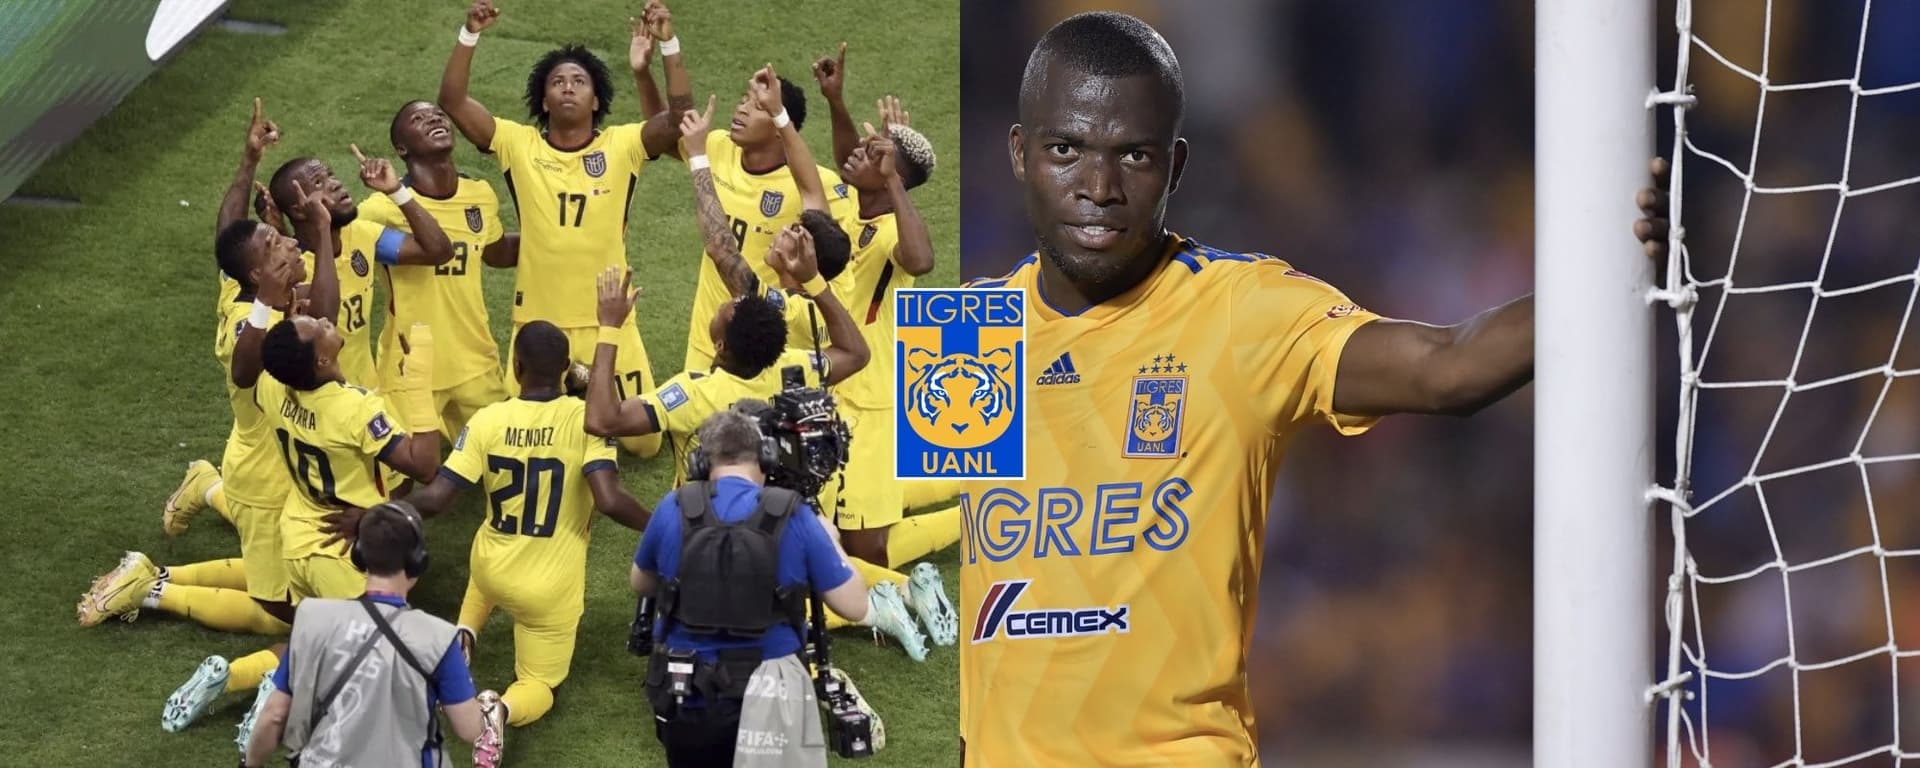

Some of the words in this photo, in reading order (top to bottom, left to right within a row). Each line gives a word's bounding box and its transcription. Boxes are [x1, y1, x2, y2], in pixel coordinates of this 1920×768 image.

[558, 192, 587, 227] 17
[726, 214, 748, 253] 9
[342, 294, 367, 333] 13
[1036, 373, 1081, 386] adidas
[1136, 380, 1183, 394] TIGRES
[504, 426, 554, 447] MENDEZ
[1136, 442, 1166, 453] UANL
[275, 427, 336, 508] 10
[487, 454, 565, 538] 20
[960, 477, 1194, 567] IGRES
[1005, 607, 1128, 636] CEMEX
